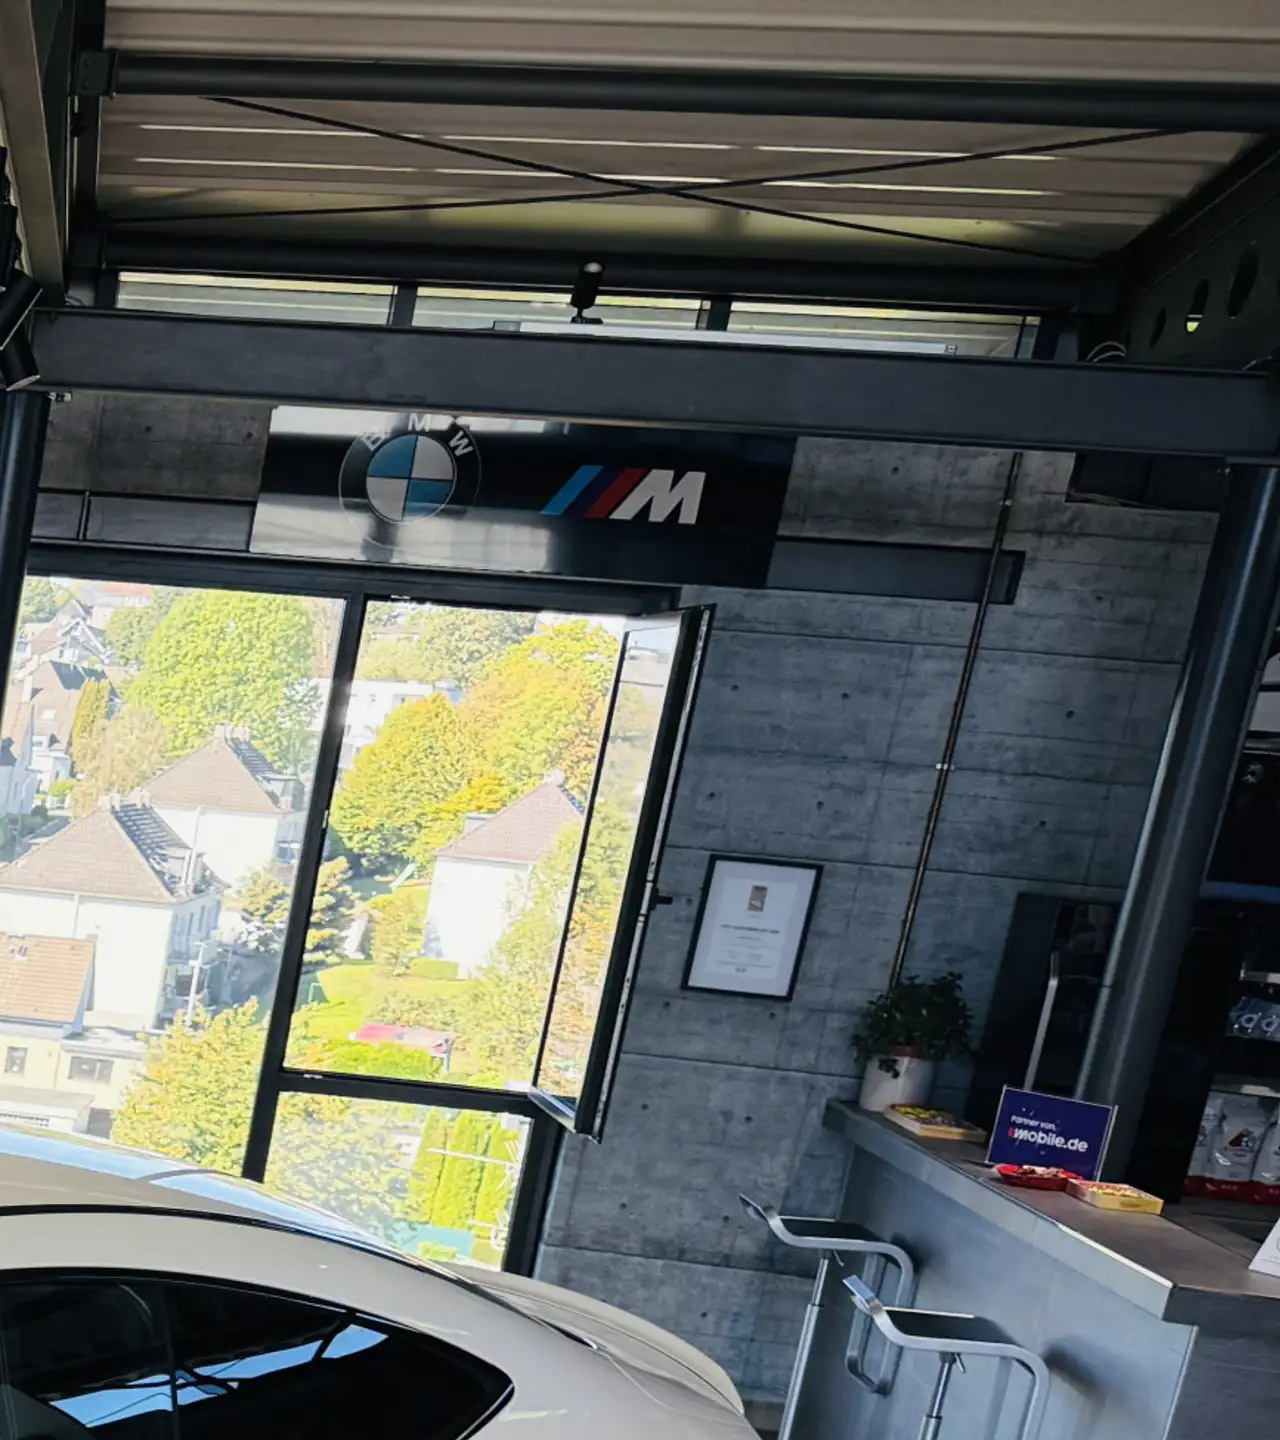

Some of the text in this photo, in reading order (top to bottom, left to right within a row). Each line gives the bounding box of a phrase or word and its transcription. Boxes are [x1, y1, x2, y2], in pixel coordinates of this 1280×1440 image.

[360, 412, 475, 457] BMW
[608, 469, 707, 525] M
[1012, 1127, 1089, 1153] mobile.de
